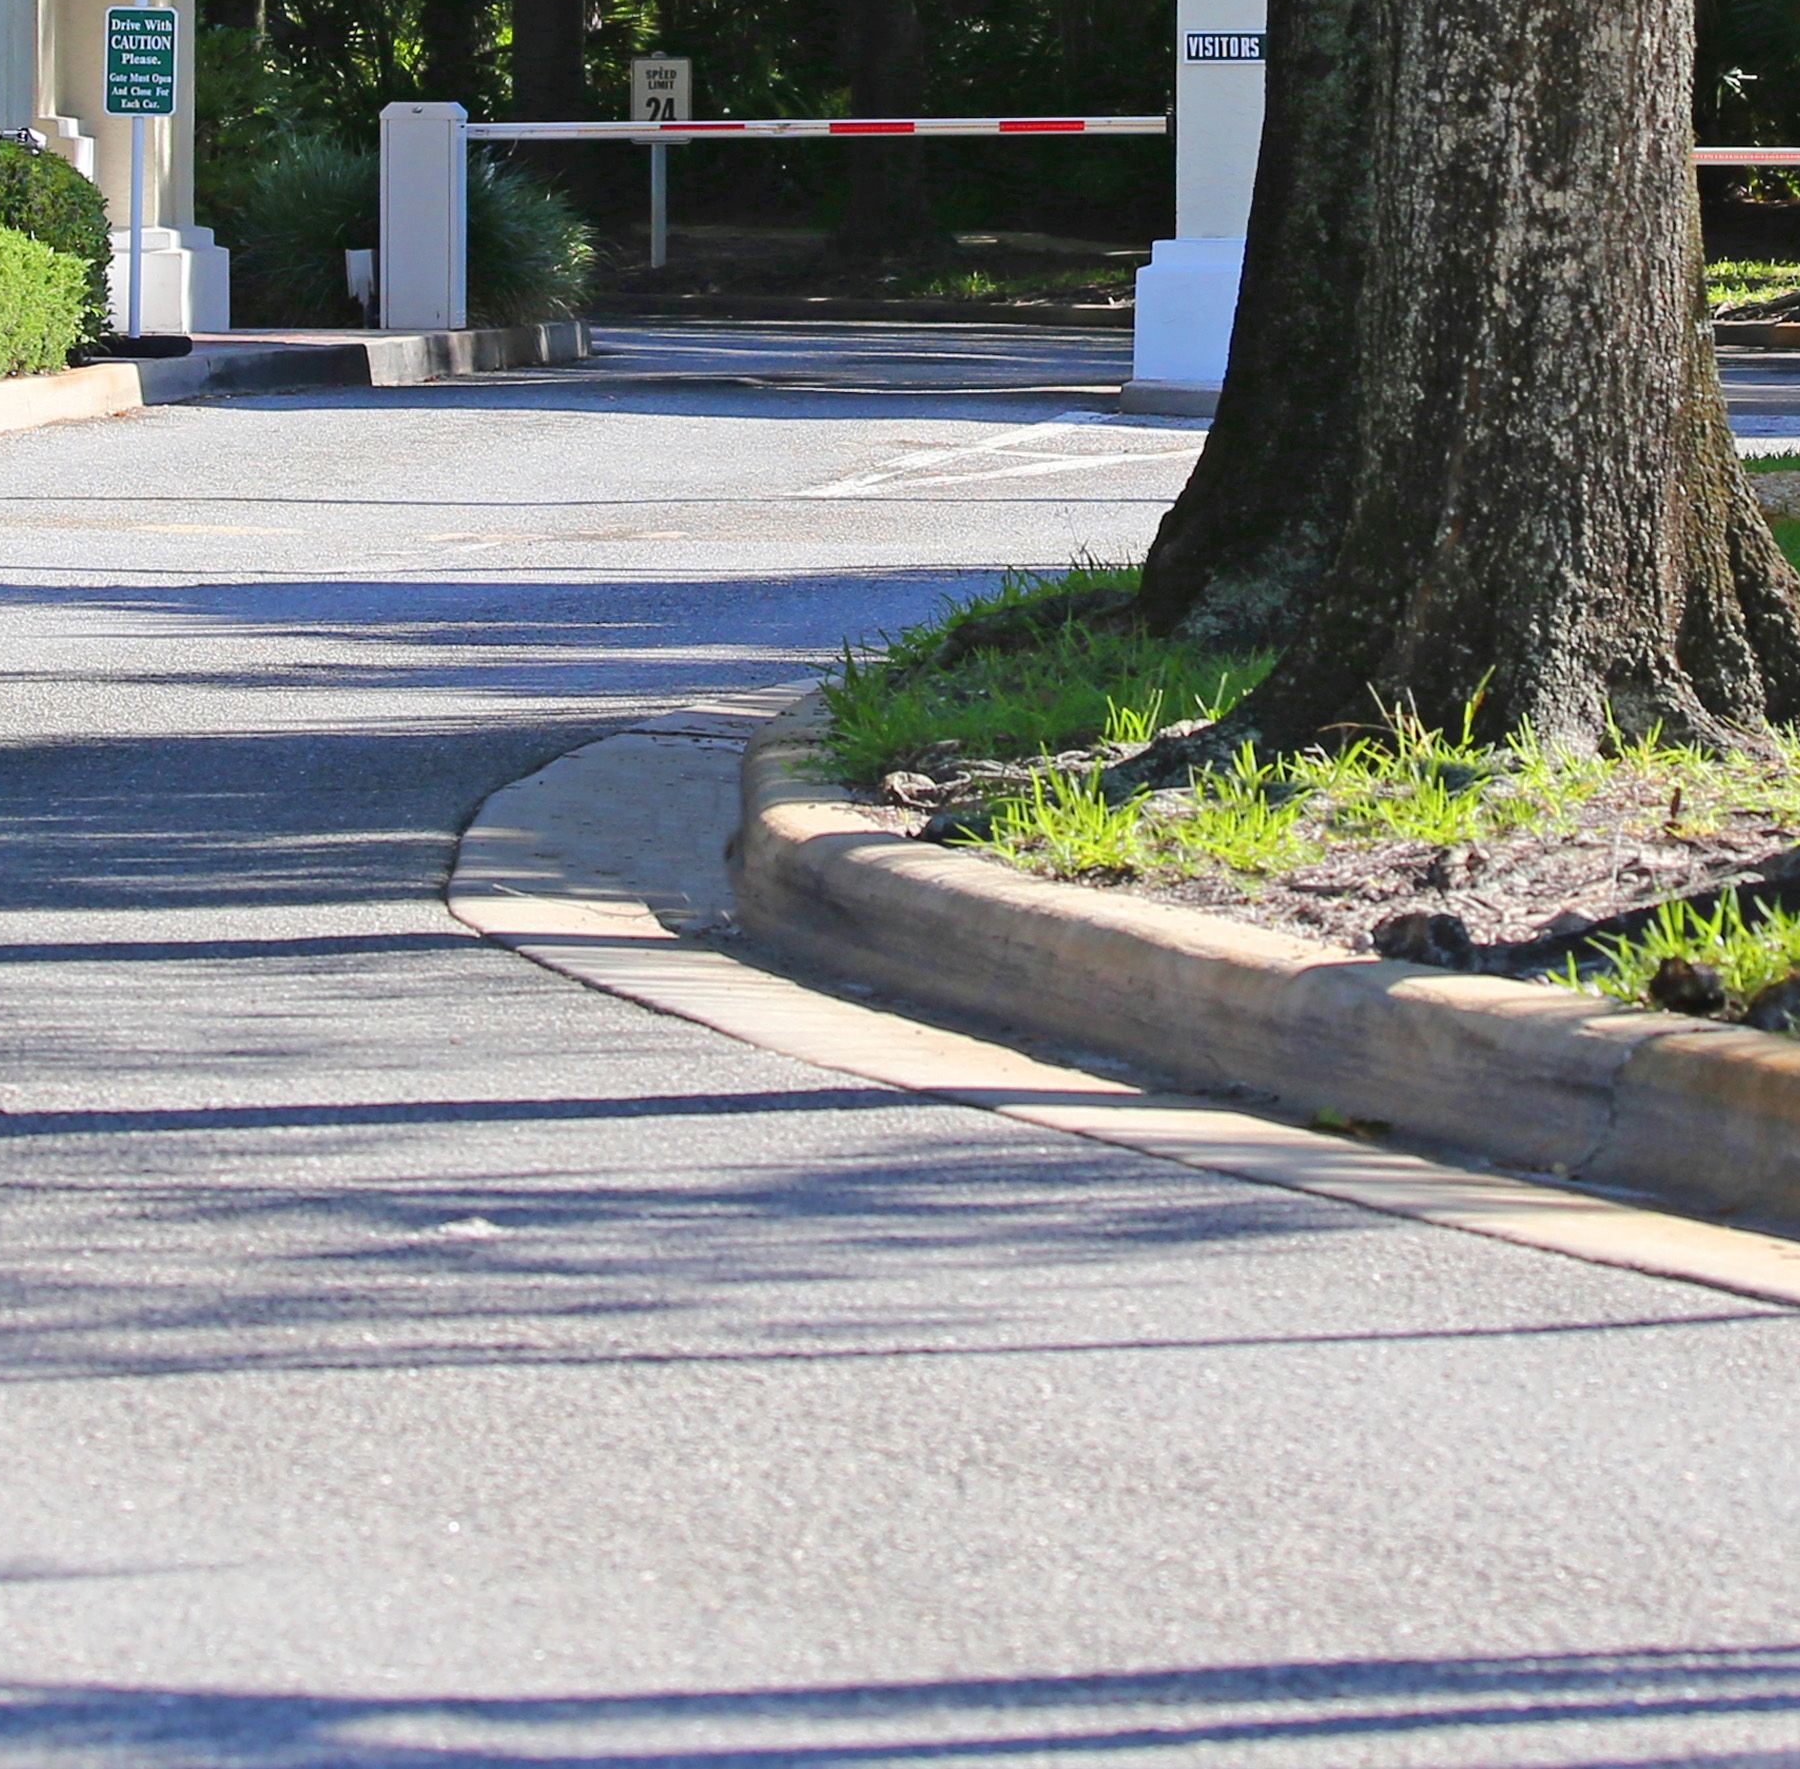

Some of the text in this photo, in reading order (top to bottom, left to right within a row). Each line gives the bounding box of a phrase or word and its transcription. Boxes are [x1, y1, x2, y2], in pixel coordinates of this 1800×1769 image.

[111, 19, 172, 31] Drive With
[111, 35, 172, 50] CAUTION
[1188, 36, 1260, 58] VISITORS
[121, 53, 161, 65] Please.
[109, 73, 172, 84] Gate Must Open
[646, 69, 677, 80] SPEED
[648, 80, 674, 90] LIMIT
[111, 87, 127, 95] And
[156, 87, 169, 96] For
[121, 99, 160, 109] Each Car.
[646, 96, 677, 121] 24
